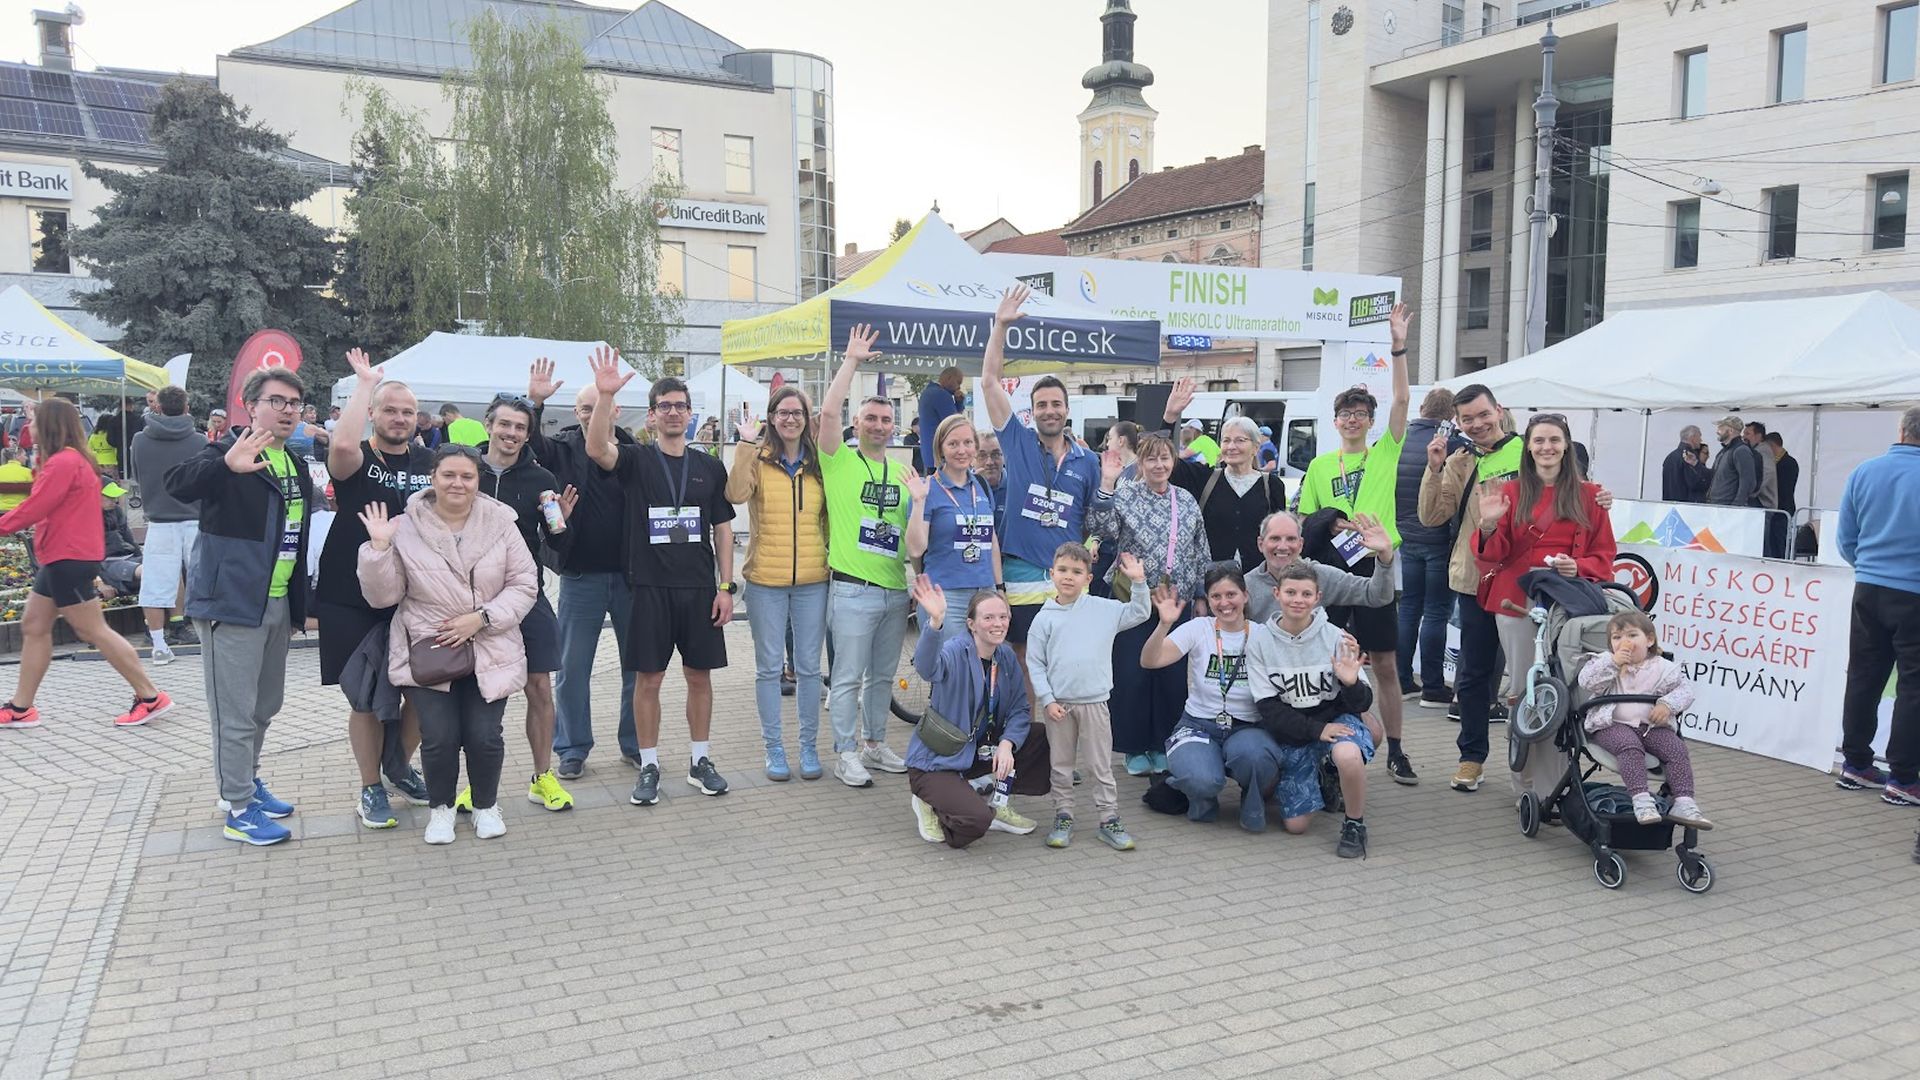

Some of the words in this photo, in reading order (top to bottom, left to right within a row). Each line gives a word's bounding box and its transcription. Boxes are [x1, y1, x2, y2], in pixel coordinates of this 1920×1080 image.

[18, 170, 68, 191] Bank
[670, 204, 731, 223] UniCredit
[733, 209, 765, 226] Bank
[1169, 270, 1247, 305] FINISH
[1306, 311, 1343, 322] MISKOLC
[1352, 298, 1369, 319] 118
[1167, 311, 1222, 329] MISKOLC
[1226, 312, 1301, 333] Ultramarathon
[1665, 562, 1822, 601] MISKOLC
[1664, 593, 1819, 635] EGÉSZSÉGES
[1662, 624, 1815, 668] IFJÚSÁGÁÉRT
